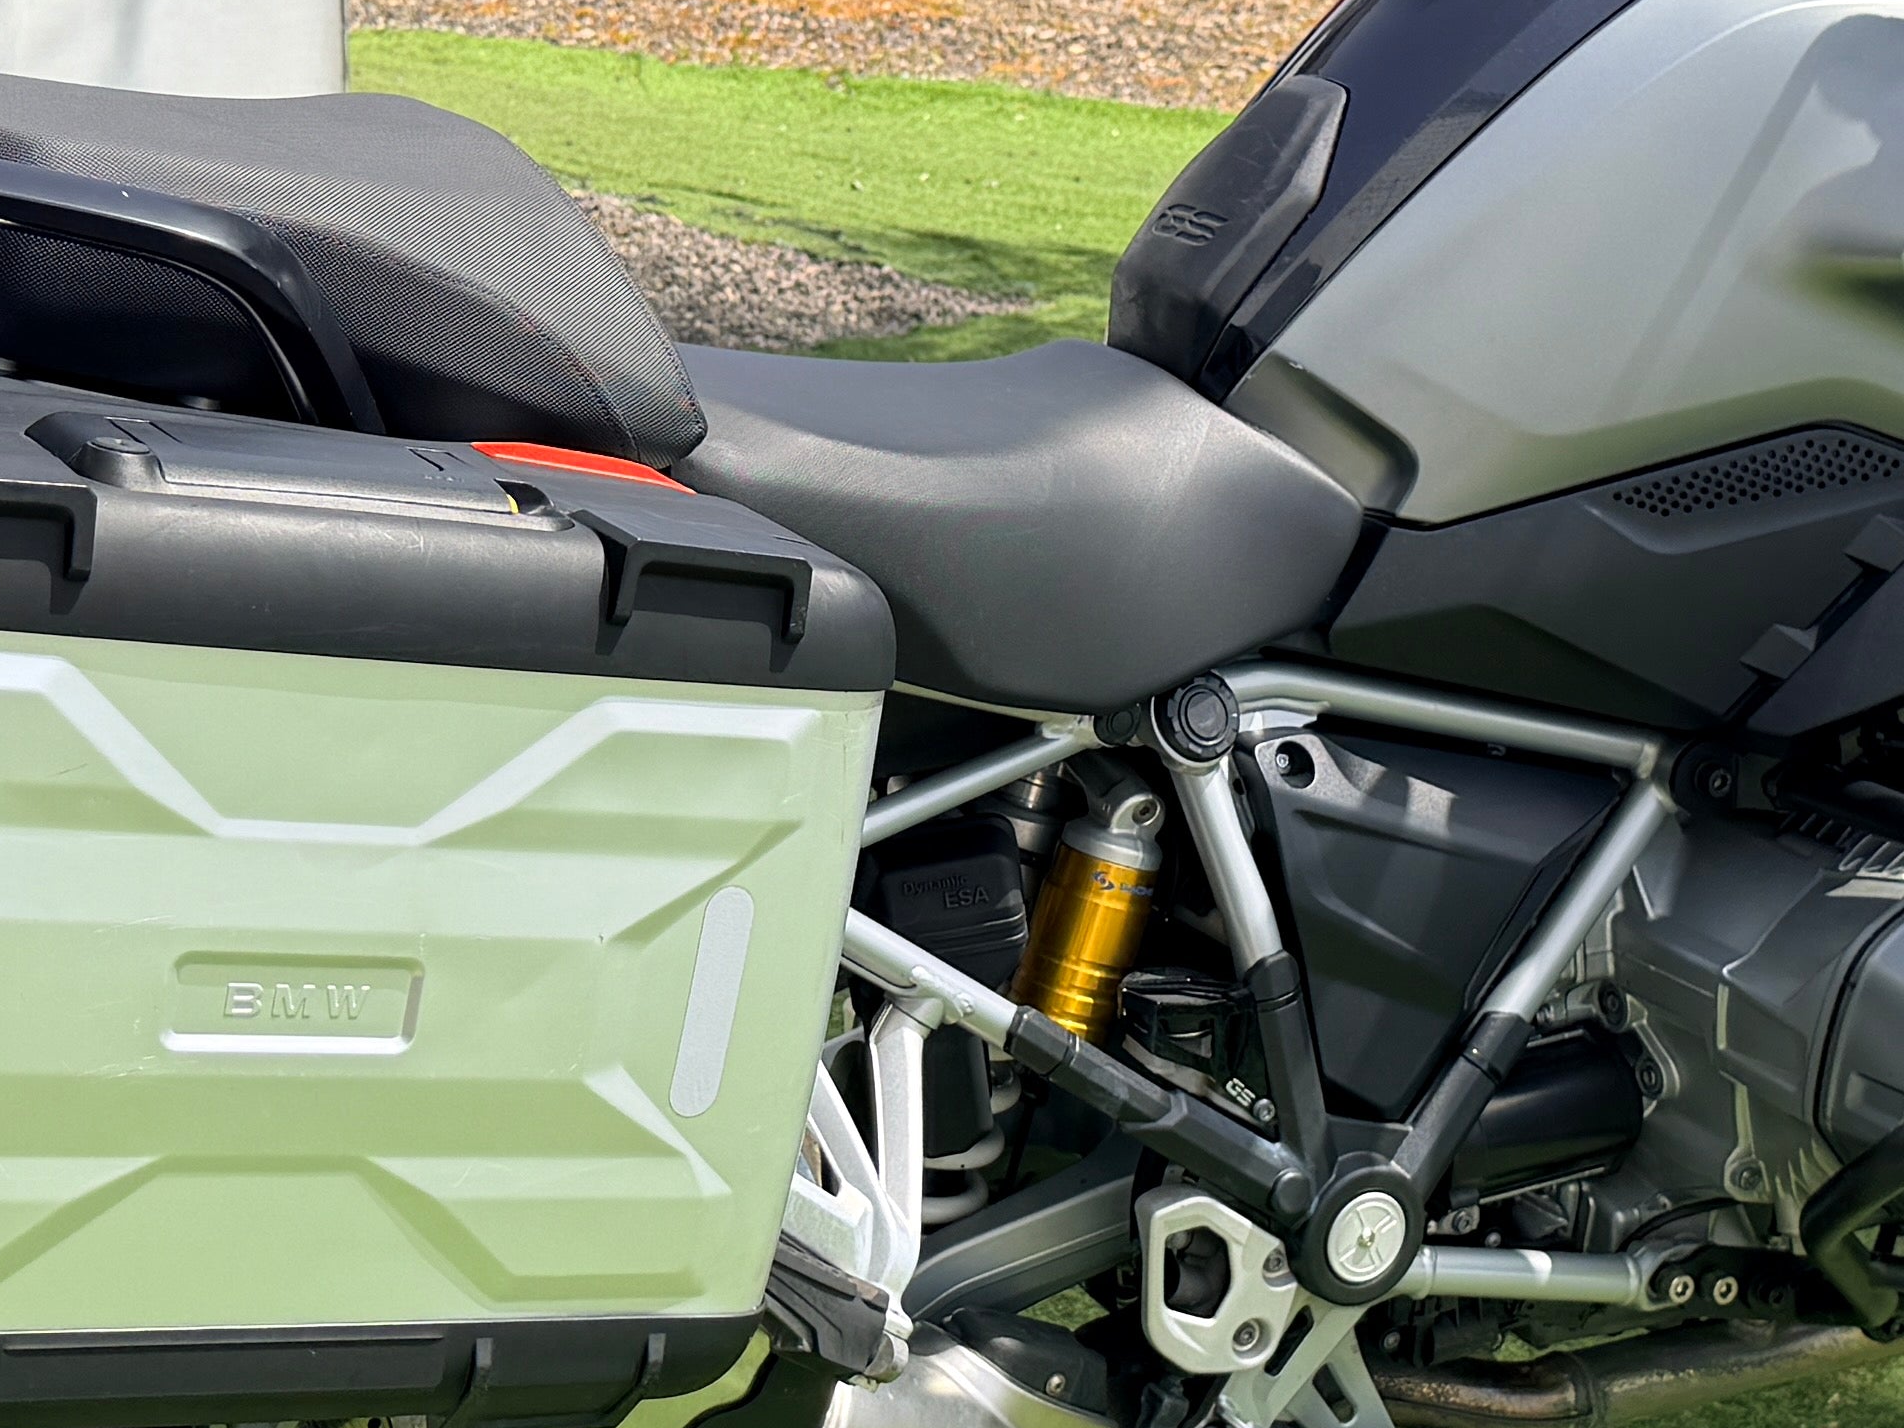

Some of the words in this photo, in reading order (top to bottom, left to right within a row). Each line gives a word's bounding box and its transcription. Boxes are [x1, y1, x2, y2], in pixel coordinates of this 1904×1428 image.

[944, 886, 990, 909] ESA
[222, 980, 374, 1020] BMW
[1225, 1077, 1257, 1107] GS
